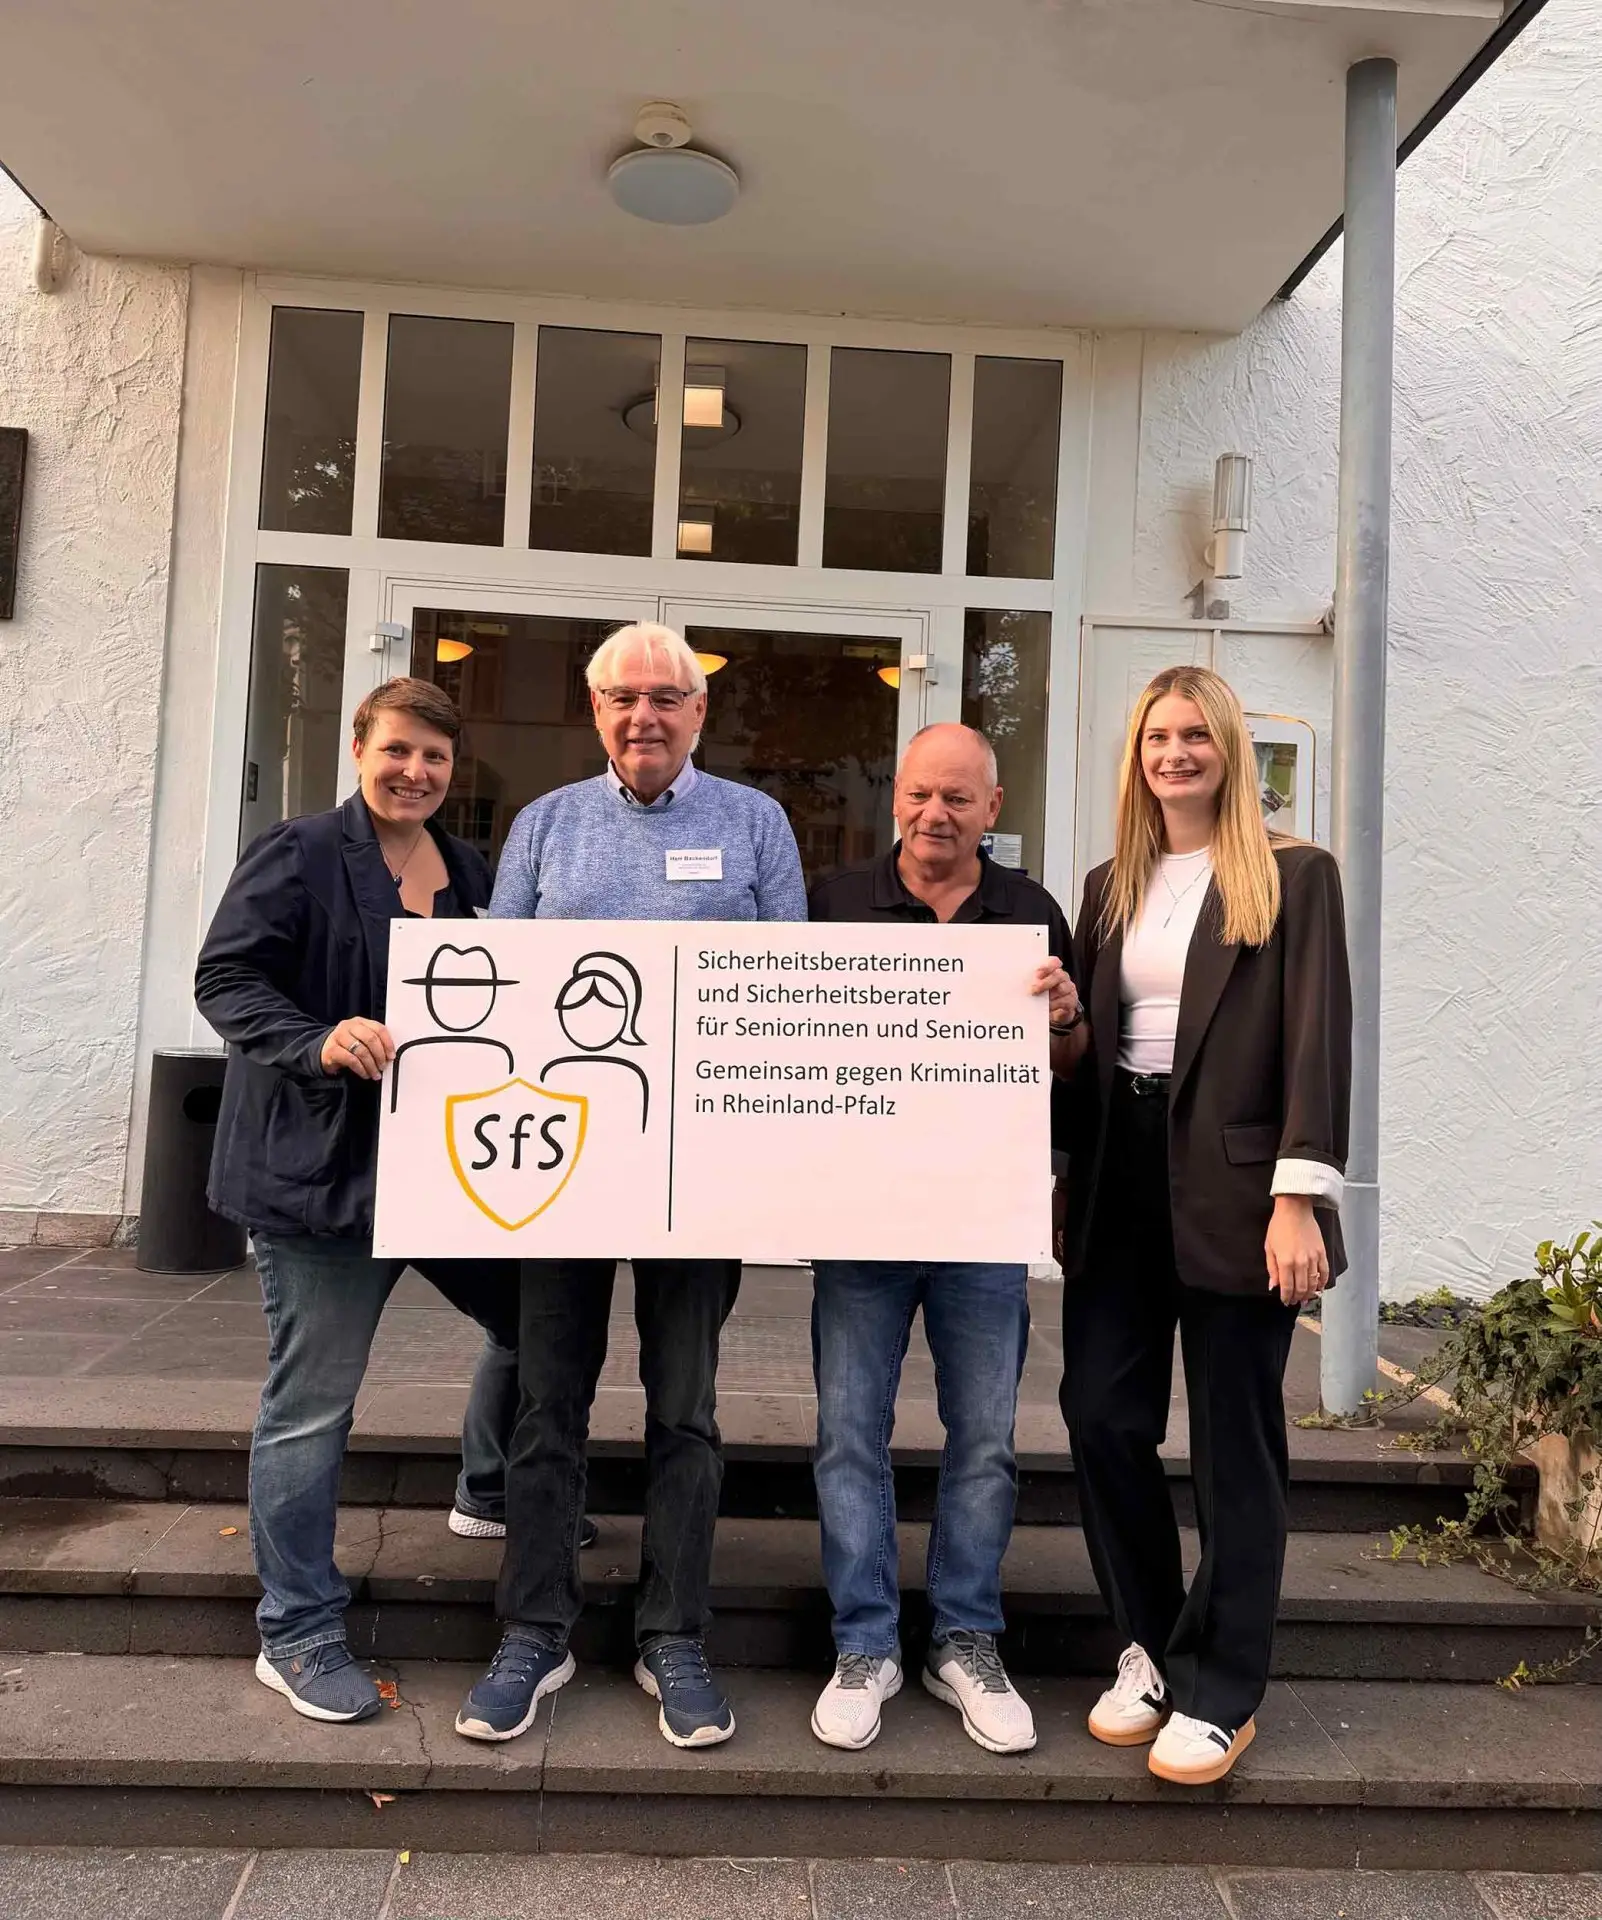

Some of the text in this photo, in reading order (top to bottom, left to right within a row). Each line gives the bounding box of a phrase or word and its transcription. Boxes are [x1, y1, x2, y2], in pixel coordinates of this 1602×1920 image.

[697, 949, 964, 973] Sicherheitsberaterinnen
[698, 982, 952, 1006] und Sicherheitsberater
[696, 1015, 1025, 1040] für Seniorinnen und Senioren
[695, 1059, 1040, 1086] Gemeinsam gegen Kriminalität
[695, 1093, 896, 1116] in Rheinland-Pfalz
[471, 1113, 567, 1171] SfS
